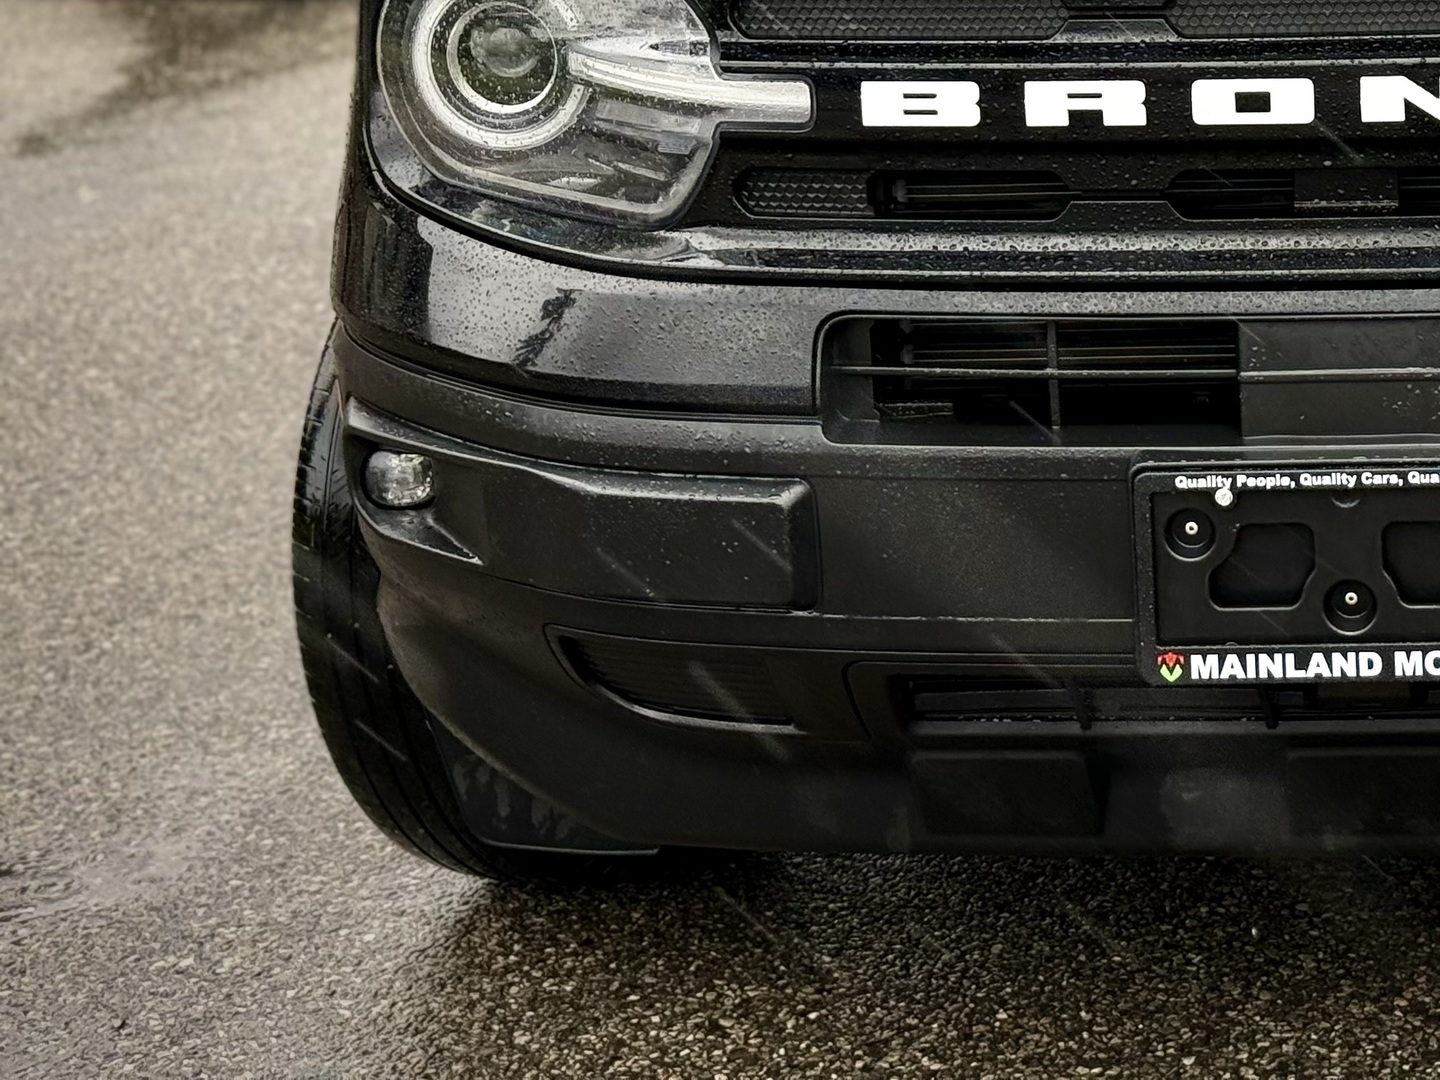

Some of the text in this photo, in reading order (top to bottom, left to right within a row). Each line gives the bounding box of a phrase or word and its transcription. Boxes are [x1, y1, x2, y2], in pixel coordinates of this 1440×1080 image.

[1174, 474, 1234, 491] Quality
[1236, 473, 1297, 491] People,
[1299, 472, 1358, 490] Quality
[1360, 471, 1404, 488] Cars,
[1189, 651, 1384, 681] MAINLAND
